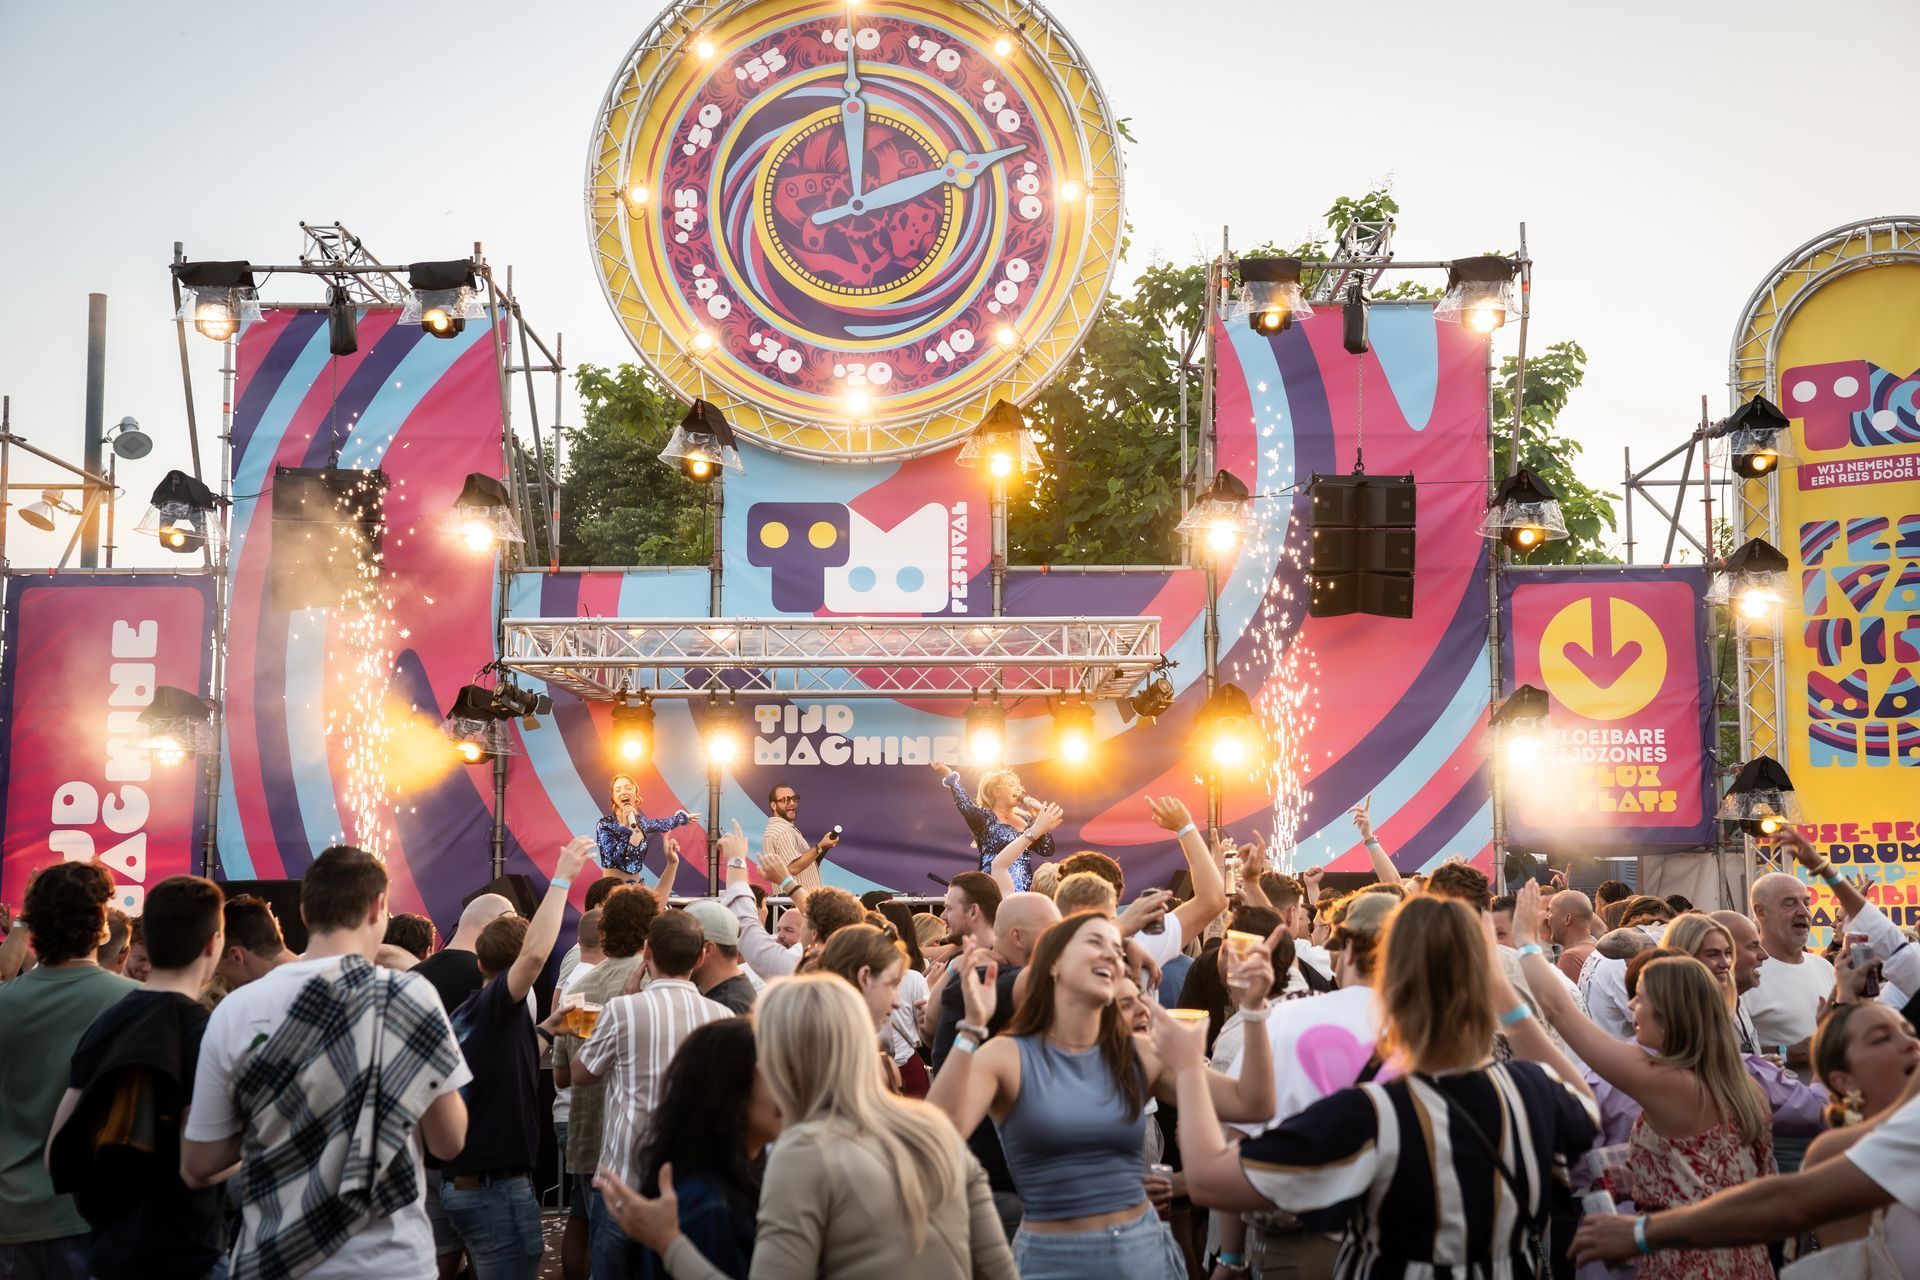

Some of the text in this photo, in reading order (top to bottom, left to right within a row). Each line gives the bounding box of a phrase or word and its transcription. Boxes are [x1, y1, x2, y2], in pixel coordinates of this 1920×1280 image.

[735, 47, 787, 83] '55
[907, 35, 961, 72] '70
[982, 79, 1021, 133] '80
[682, 104, 723, 157] '50
[1017, 161, 1042, 220] '90
[674, 188, 699, 244] '45
[692, 264, 732, 319] '40
[987, 258, 1030, 313] '00
[749, 332, 803, 374] '30
[925, 328, 975, 365] '10
[832, 361, 893, 385] '20
[1811, 475, 1835, 486] EEN
[1838, 472, 1870, 483] REIS
[1873, 468, 1914, 480] DOOR
[1817, 464, 1843, 475] WIJ
[1847, 459, 1895, 472] NEMEN
[1896, 457, 1912, 467] JE
[951, 501, 968, 613] FESTIVAL
[754, 704, 854, 734] TIJD
[754, 735, 960, 765] MACHINE
[1545, 747, 1668, 762] IJDZONES
